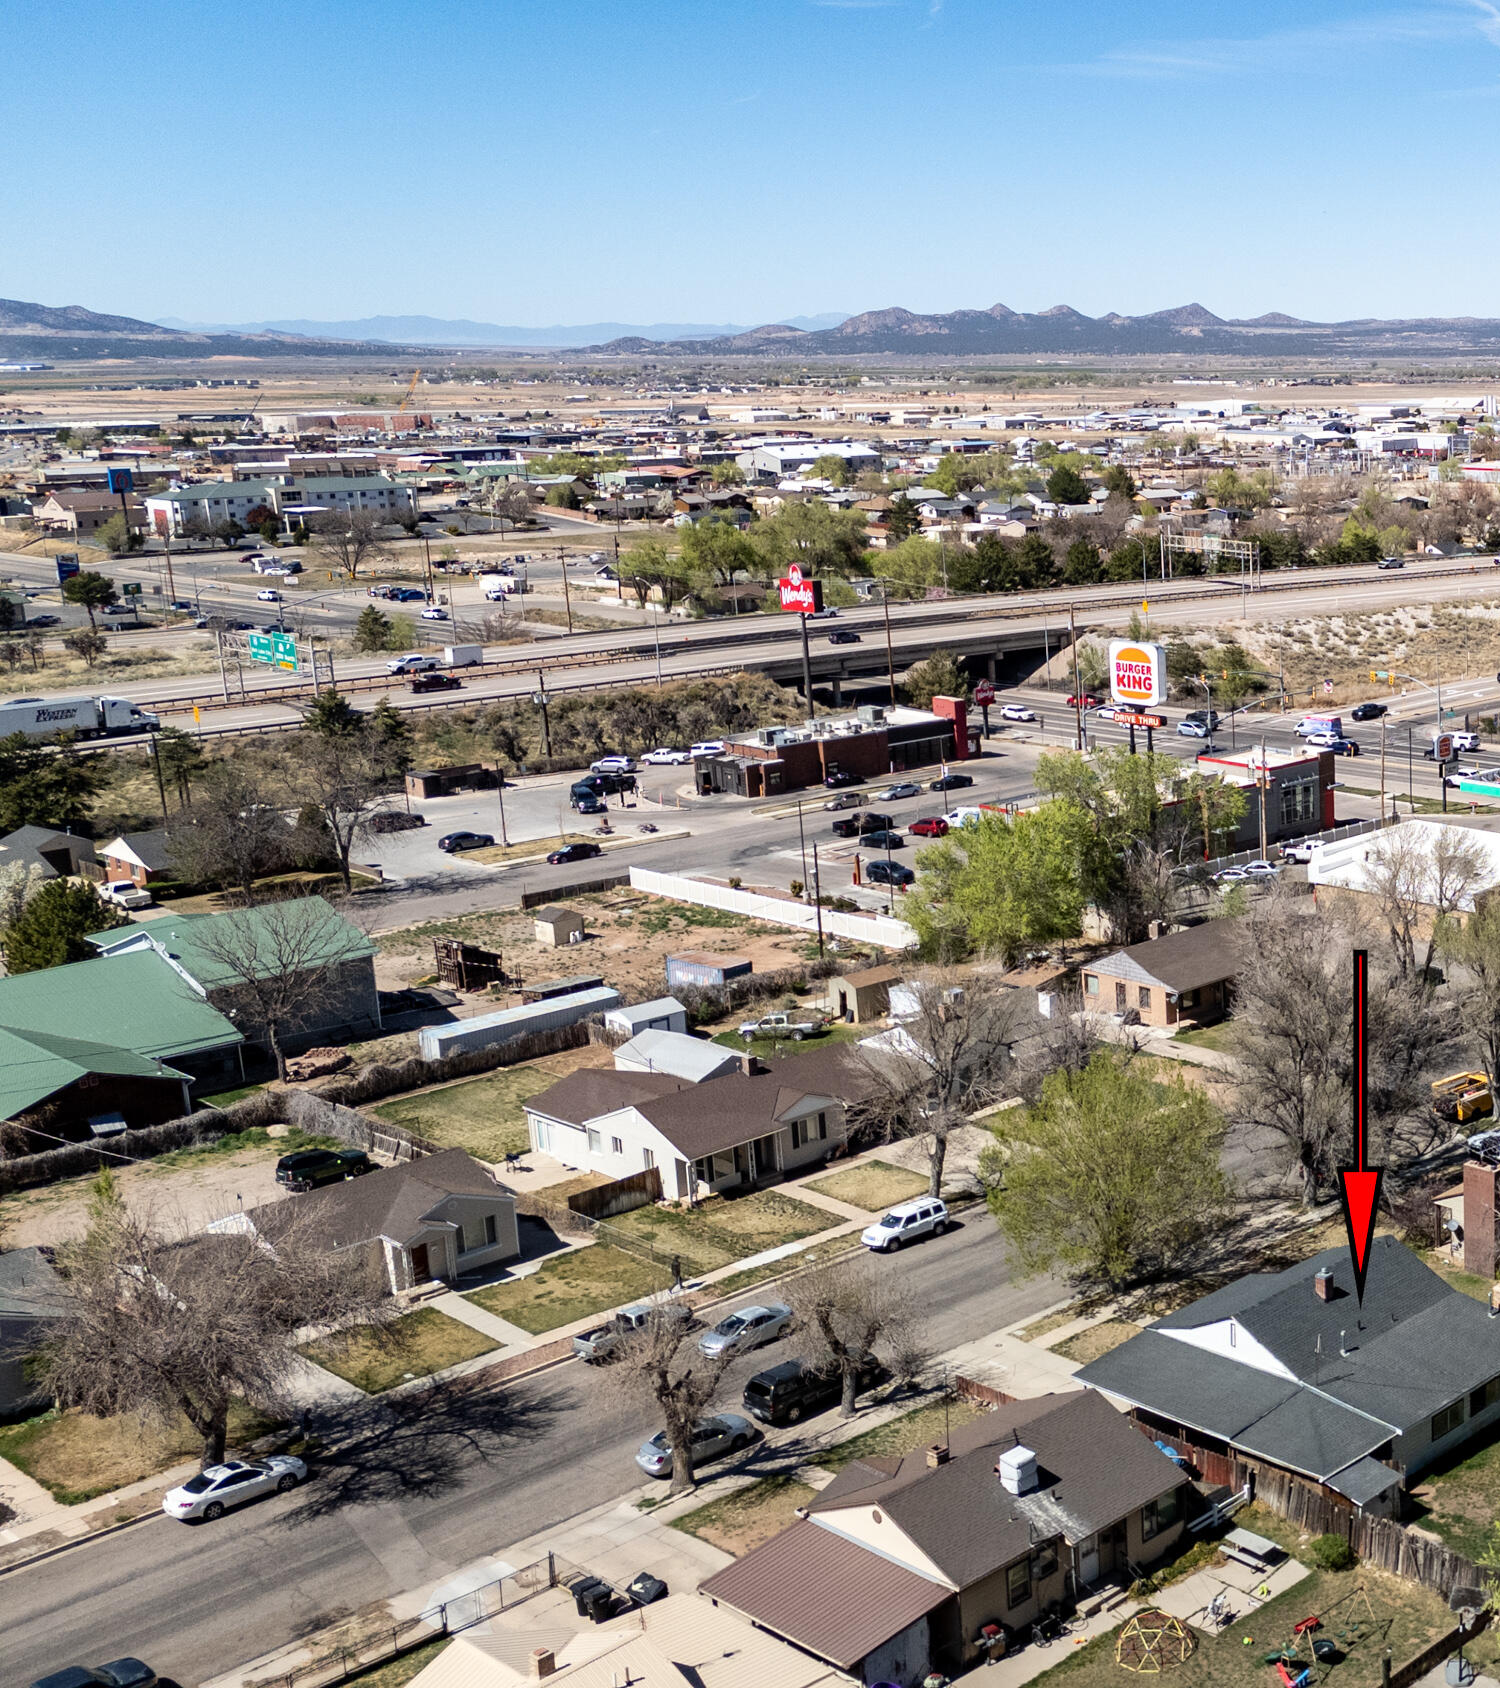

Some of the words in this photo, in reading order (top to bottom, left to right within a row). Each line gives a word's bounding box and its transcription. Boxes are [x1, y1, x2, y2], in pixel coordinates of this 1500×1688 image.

[116, 472, 128, 489] 6
[781, 584, 812, 607] Wendy's
[1116, 662, 1152, 676] BURGER
[1117, 674, 1152, 691] KING
[1114, 713, 1136, 723] DRIVE
[1139, 716, 1159, 726] THRU
